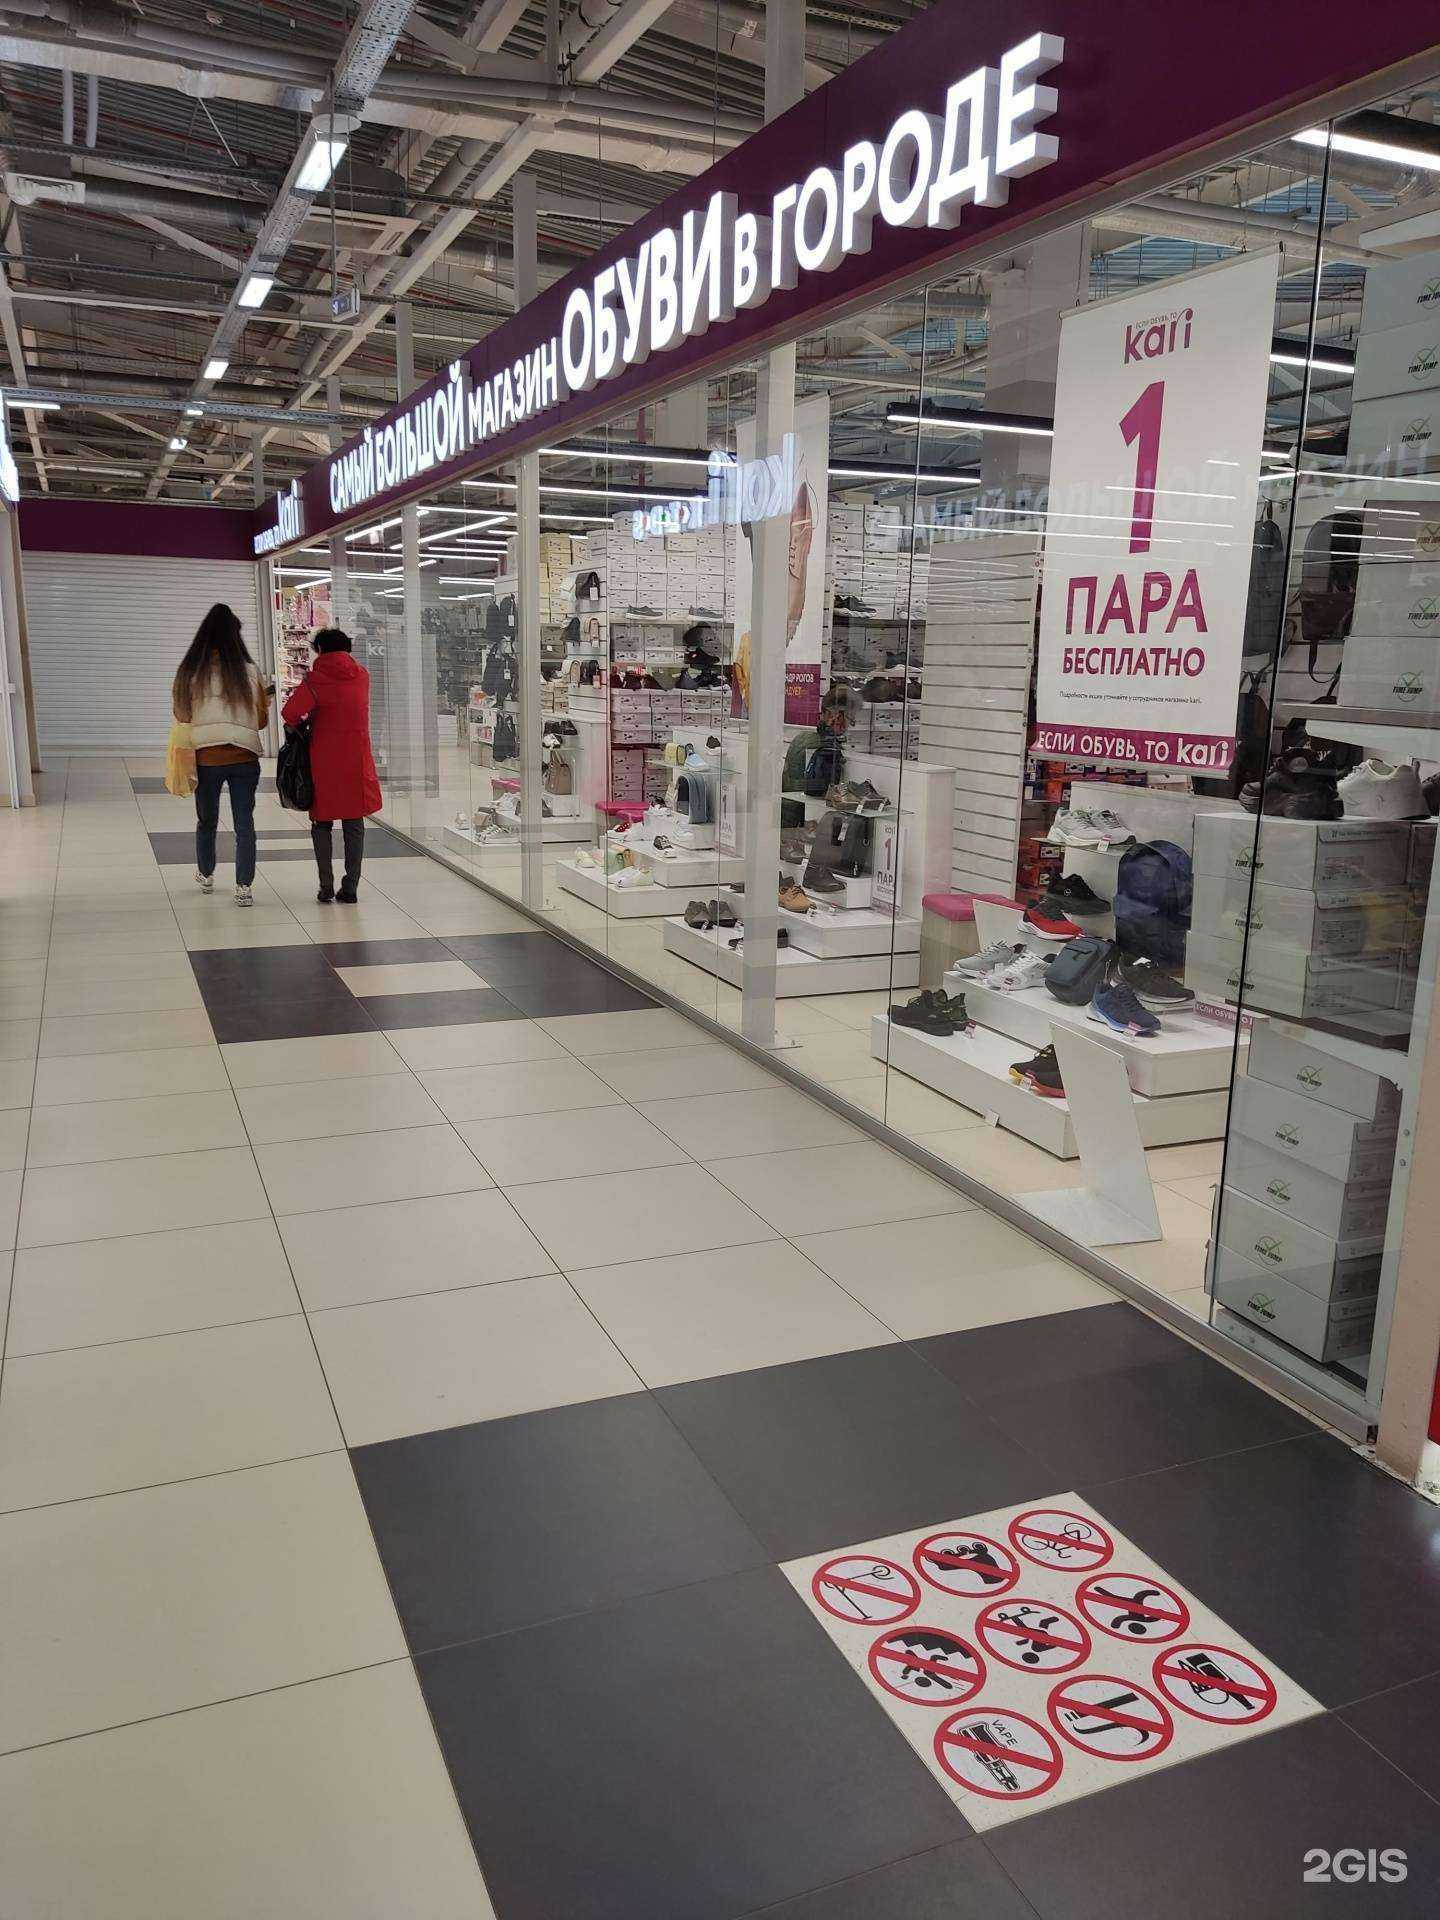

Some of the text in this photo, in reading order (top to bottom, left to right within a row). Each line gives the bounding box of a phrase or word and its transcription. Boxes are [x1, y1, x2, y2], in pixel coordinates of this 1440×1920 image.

[330, 427, 376, 514] САМЫЙ
[375, 359, 467, 491] БОЛЬШОЙ
[468, 336, 559, 444] МАГАЗИН
[562, 191, 726, 391] ОБУВИ
[771, 32, 1060, 290] ГОРОДЕ
[1124, 308, 1194, 364] kari
[1119, 380, 1165, 554] 1
[1066, 569, 1208, 634] ПАРА
[1063, 647, 1205, 677] БЕСПЛАТНО
[1037, 731, 1229, 766] ЕСЛИ ОБУВЬ, ТО kari
[877, 871, 895, 886] ПАР
[992, 1719, 1018, 1746] VAPE
